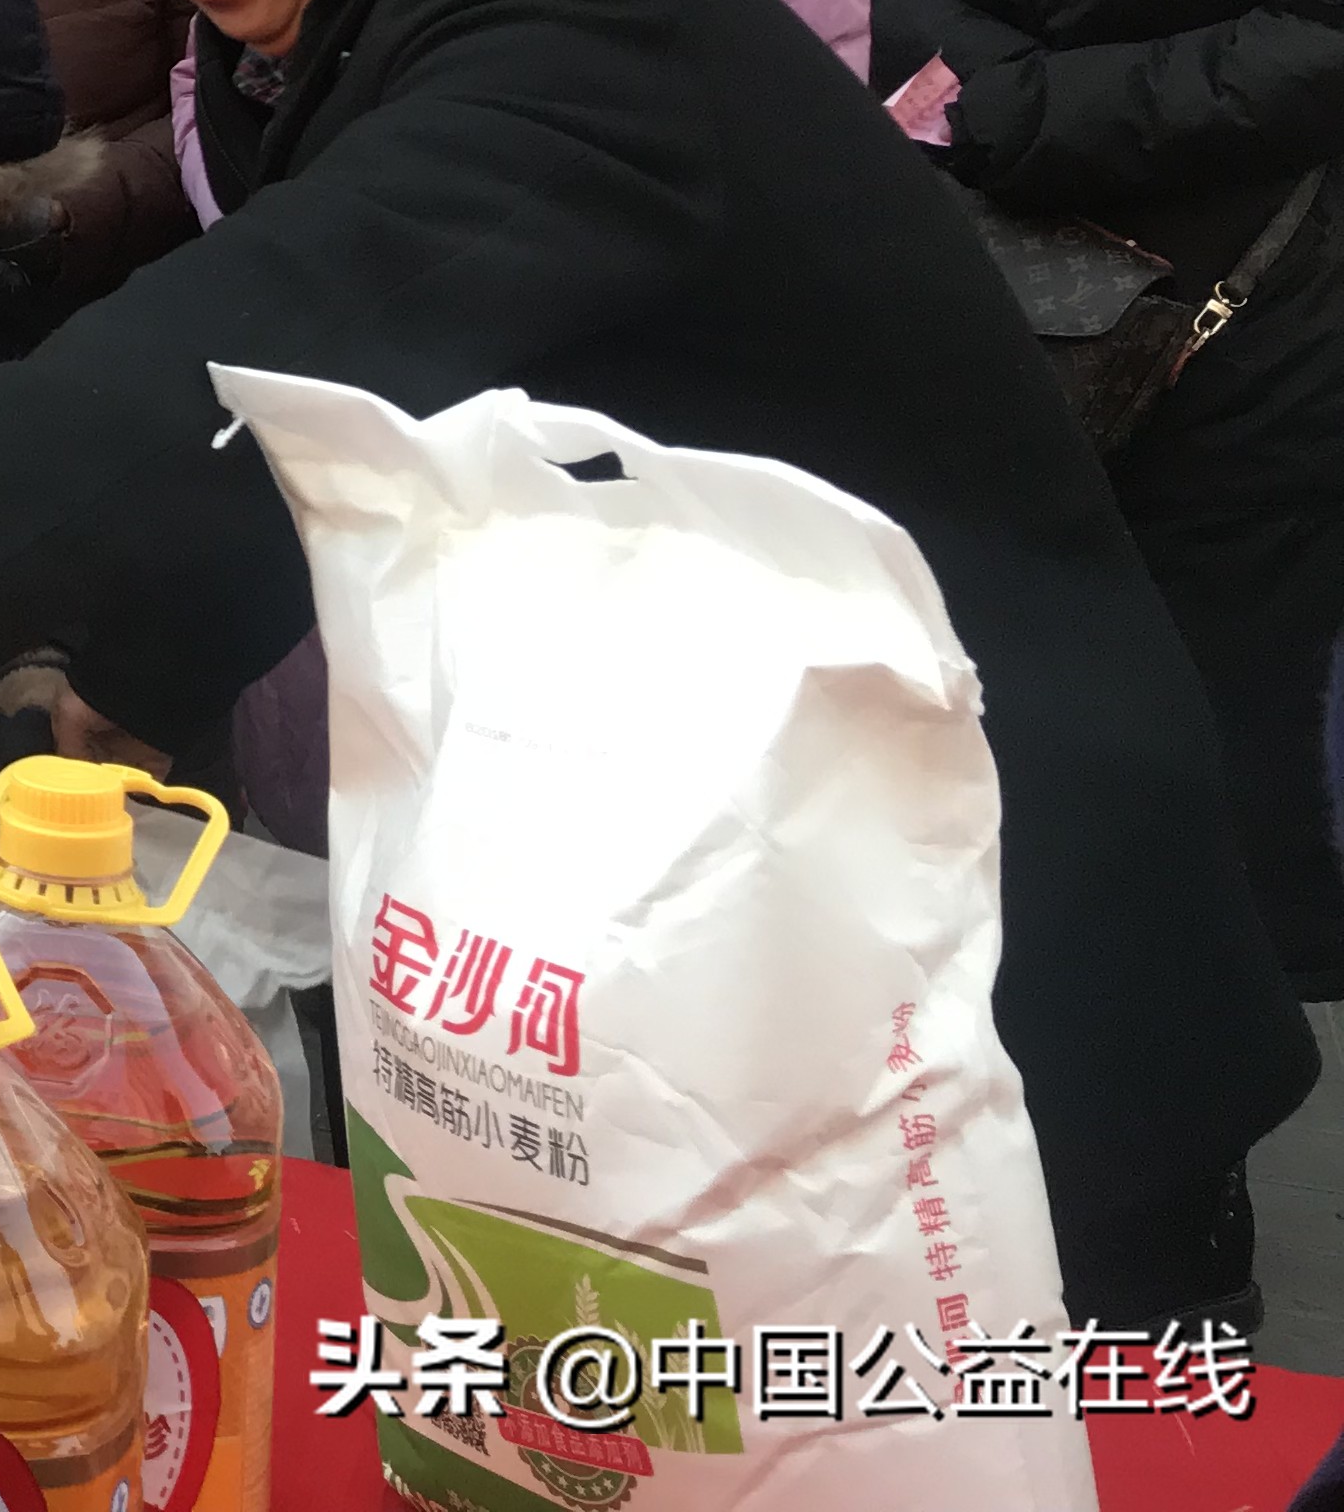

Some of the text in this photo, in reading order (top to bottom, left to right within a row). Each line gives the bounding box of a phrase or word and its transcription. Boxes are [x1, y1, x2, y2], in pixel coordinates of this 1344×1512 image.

[369, 892, 586, 1077] 金沙河
[372, 1038, 590, 1187] 特精高筋小麦粉
